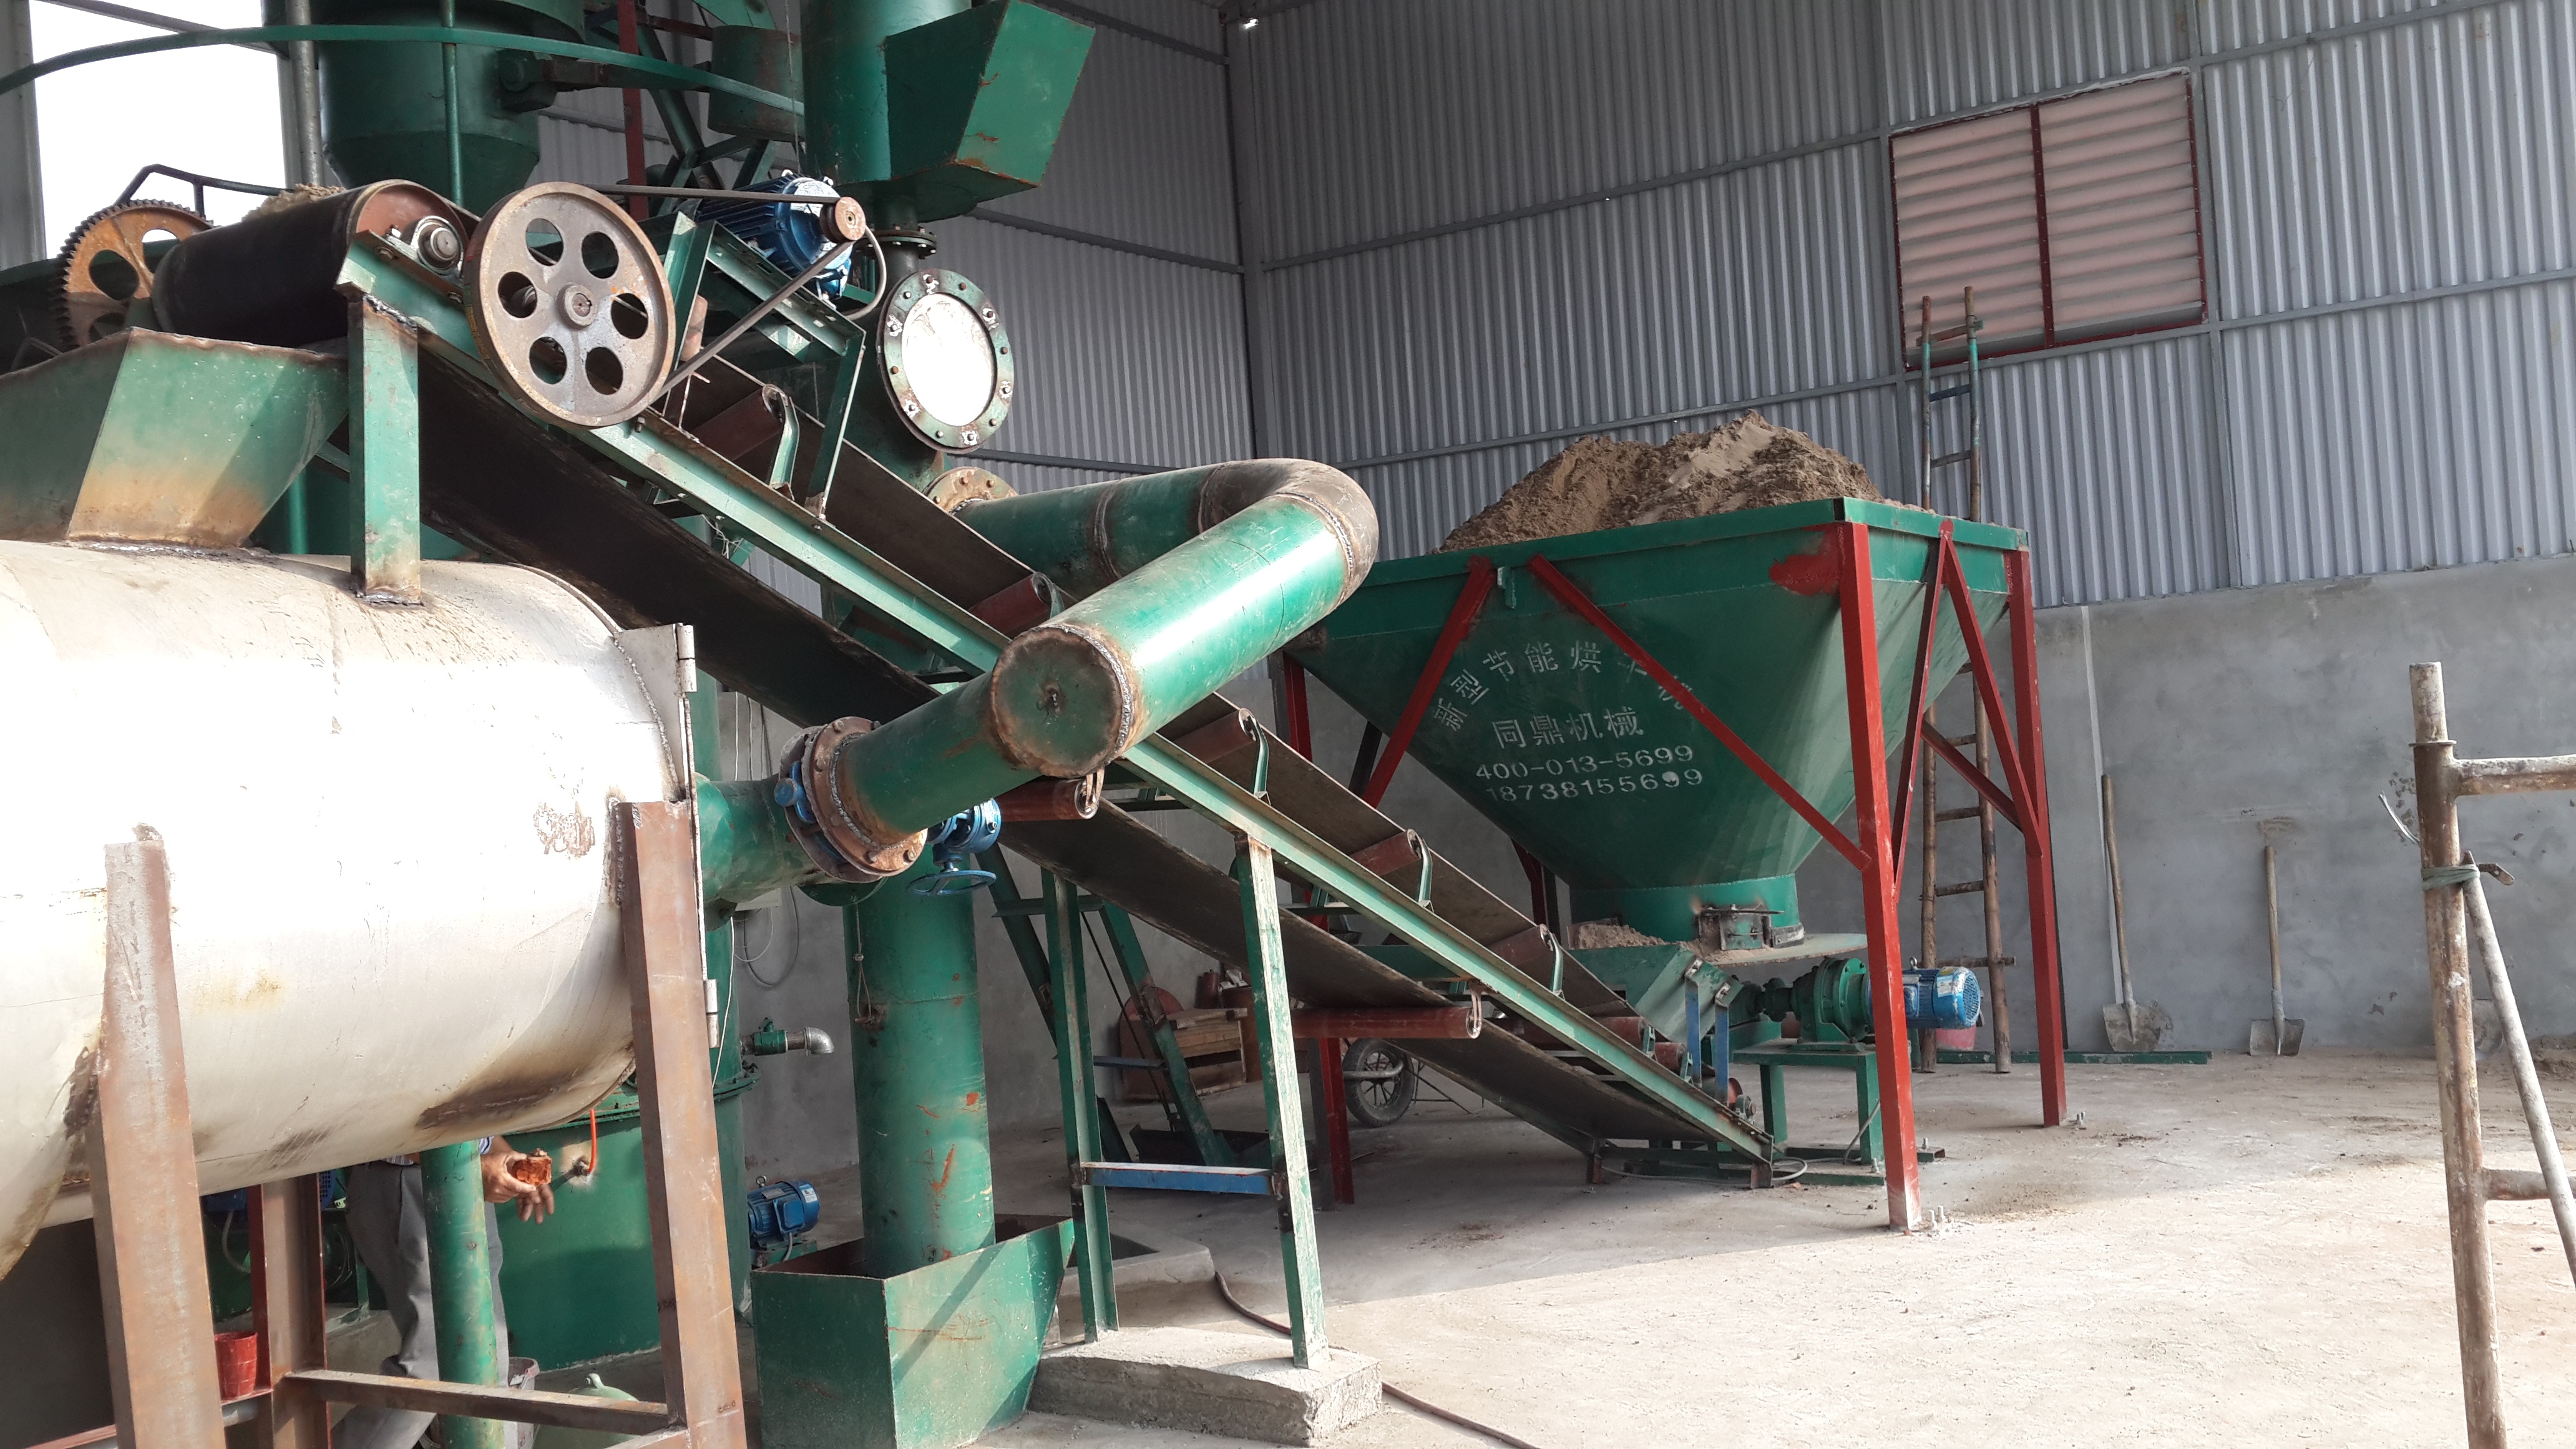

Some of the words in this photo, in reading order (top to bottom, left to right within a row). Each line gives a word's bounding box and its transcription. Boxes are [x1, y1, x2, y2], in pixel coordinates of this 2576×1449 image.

[1491, 706, 1644, 749] 同鼎机械
[1475, 744, 1694, 779] 400-013-5699
[1486, 768, 1703, 802] 18738155699
